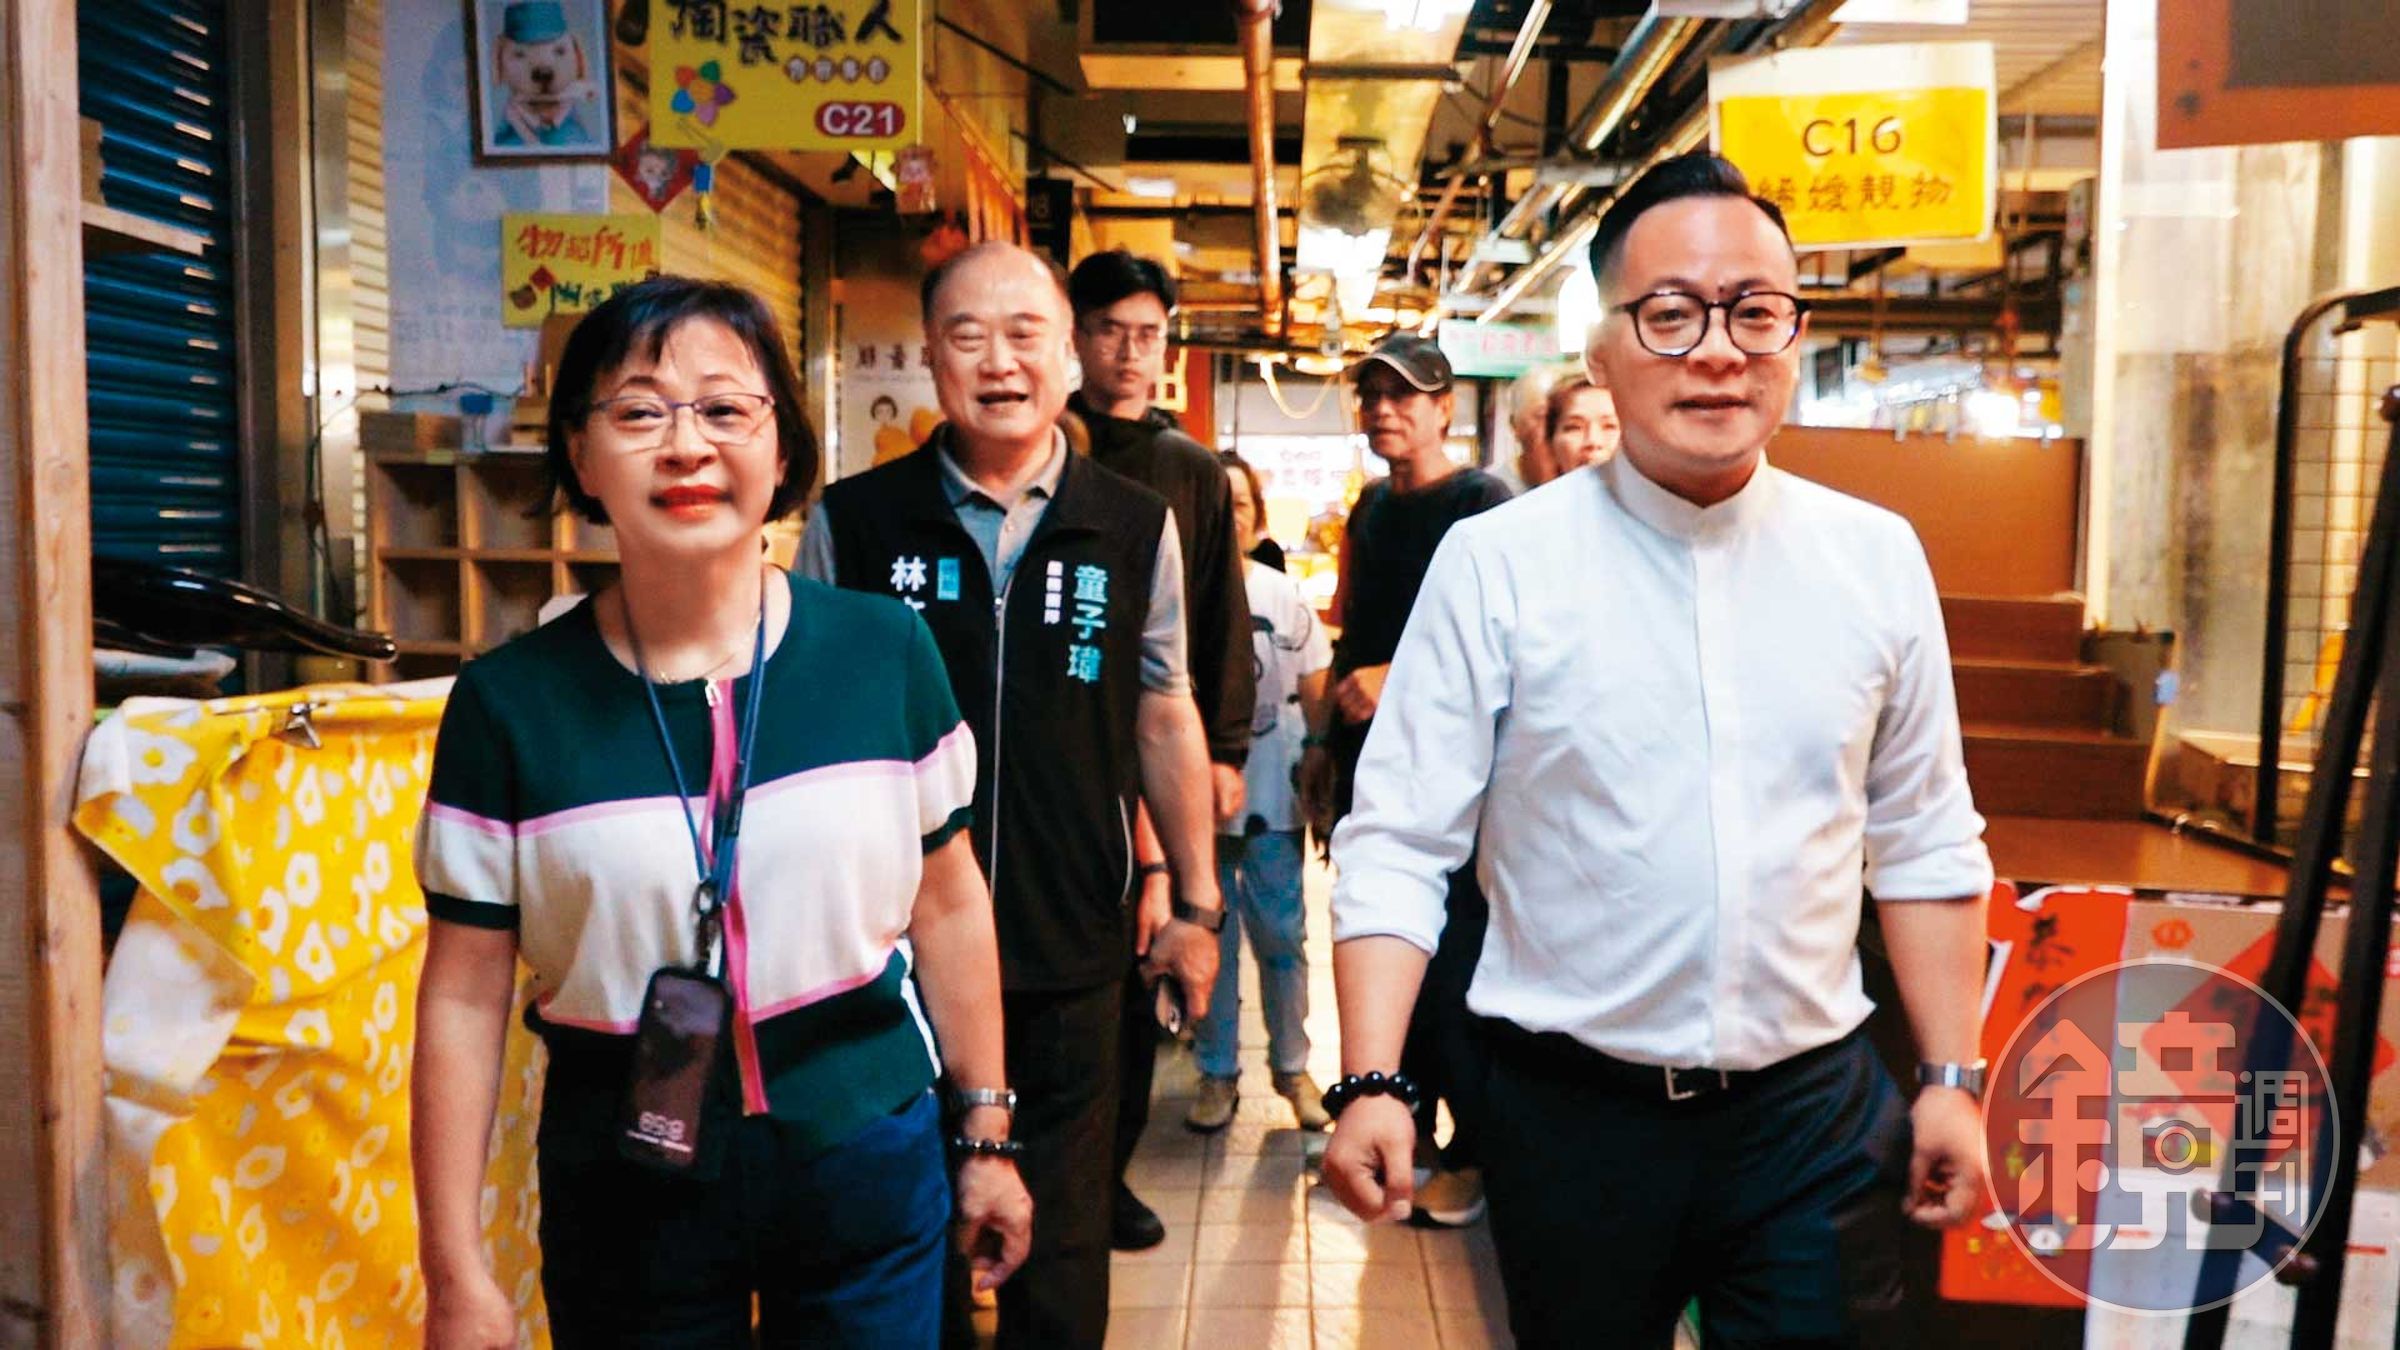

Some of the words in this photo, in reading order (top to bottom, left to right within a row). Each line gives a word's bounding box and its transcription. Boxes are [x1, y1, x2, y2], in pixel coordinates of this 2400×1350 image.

[666, 0, 903, 65] 陶瓷職人
[822, 103, 894, 135] C21
[1802, 115, 1902, 157] C16
[1066, 564, 1108, 684] 童子瑋
